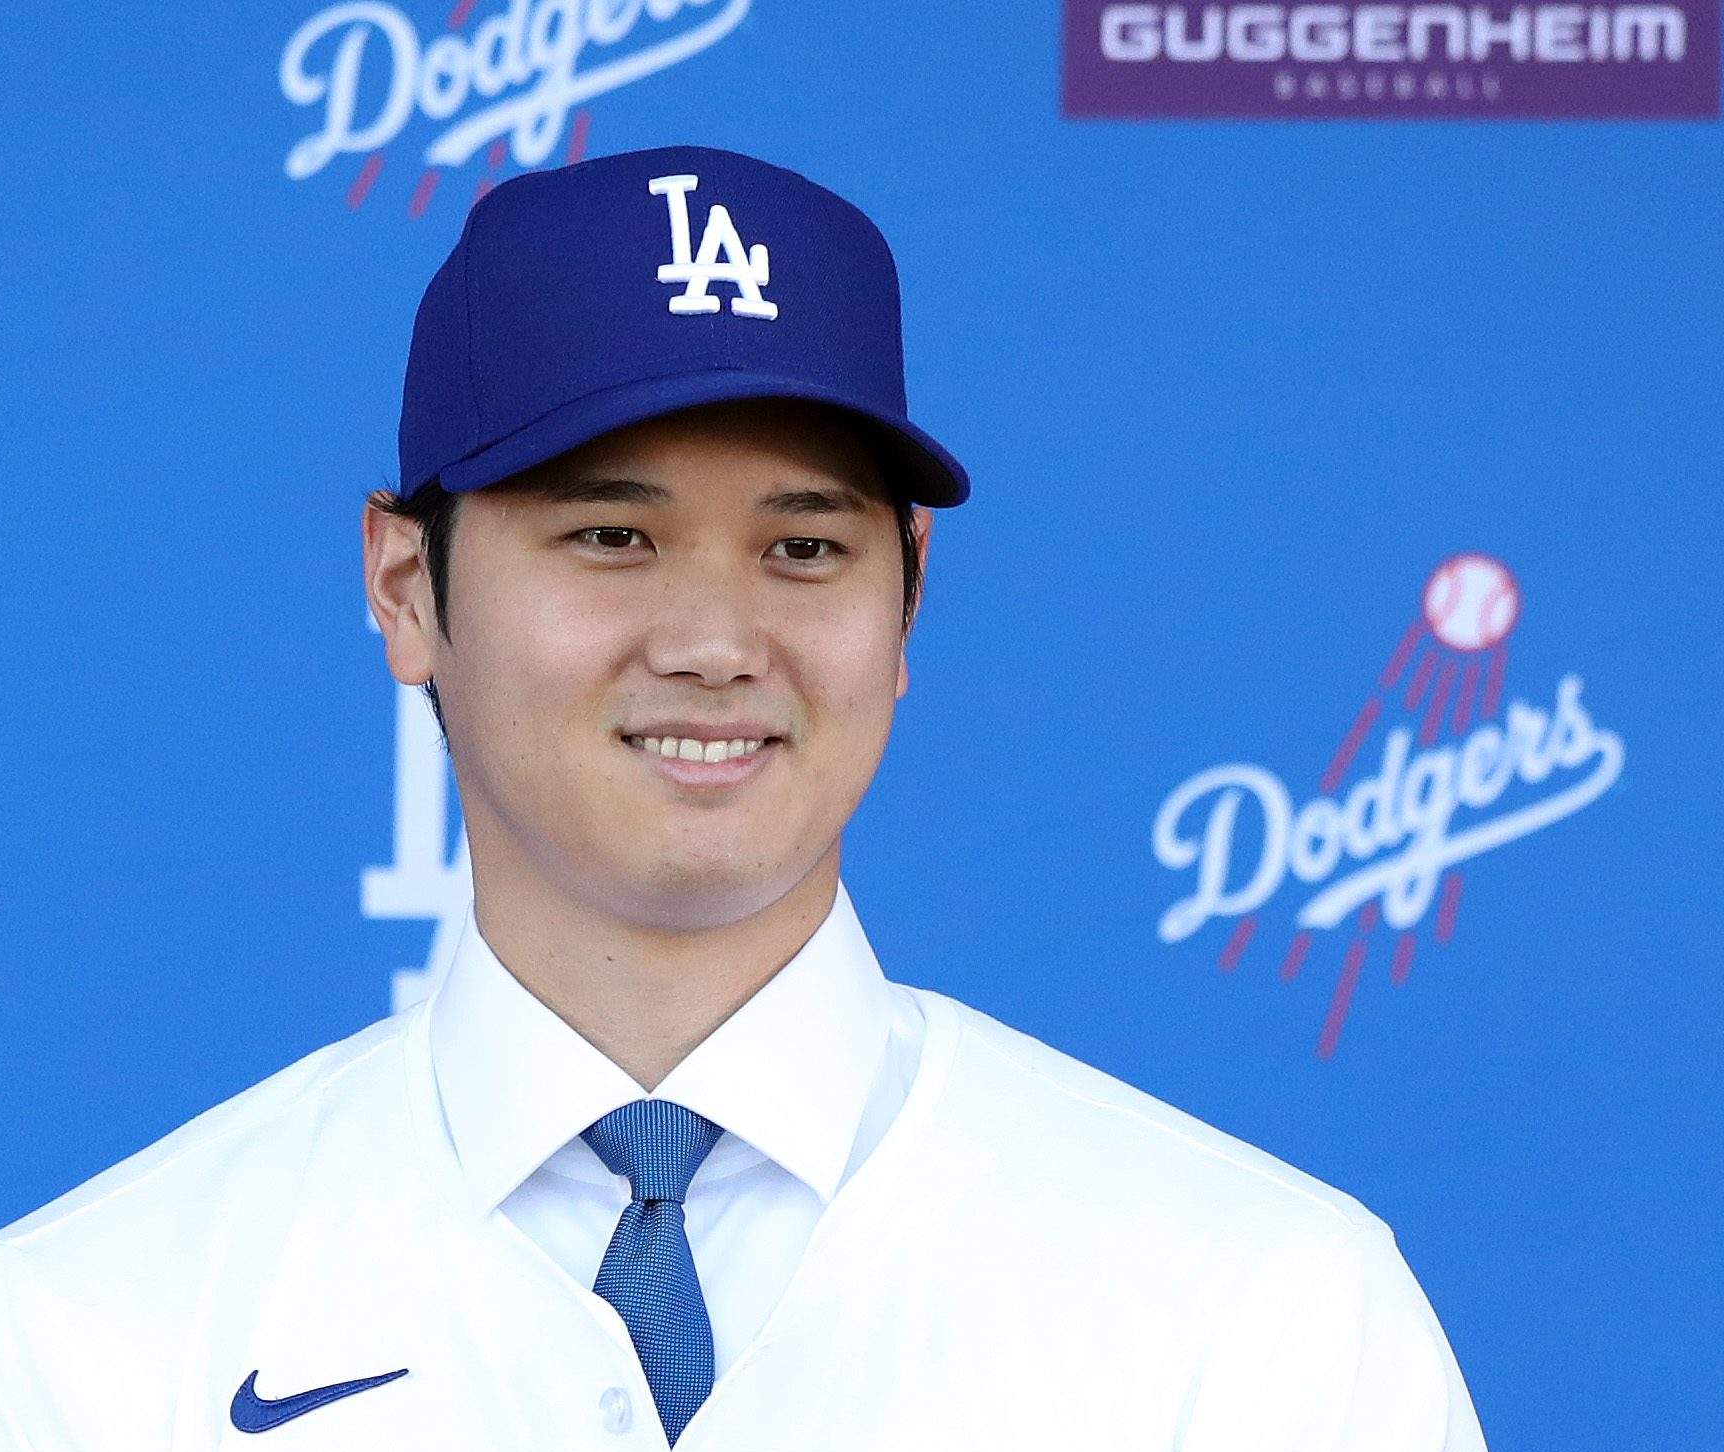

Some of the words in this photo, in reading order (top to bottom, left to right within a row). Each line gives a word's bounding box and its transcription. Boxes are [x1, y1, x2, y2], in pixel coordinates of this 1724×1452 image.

[279, 0, 752, 180] Dodge
[1100, 4, 1686, 62] GUGGENHEIM
[648, 174, 779, 321] LA
[1152, 675, 1625, 943] Dodgers
